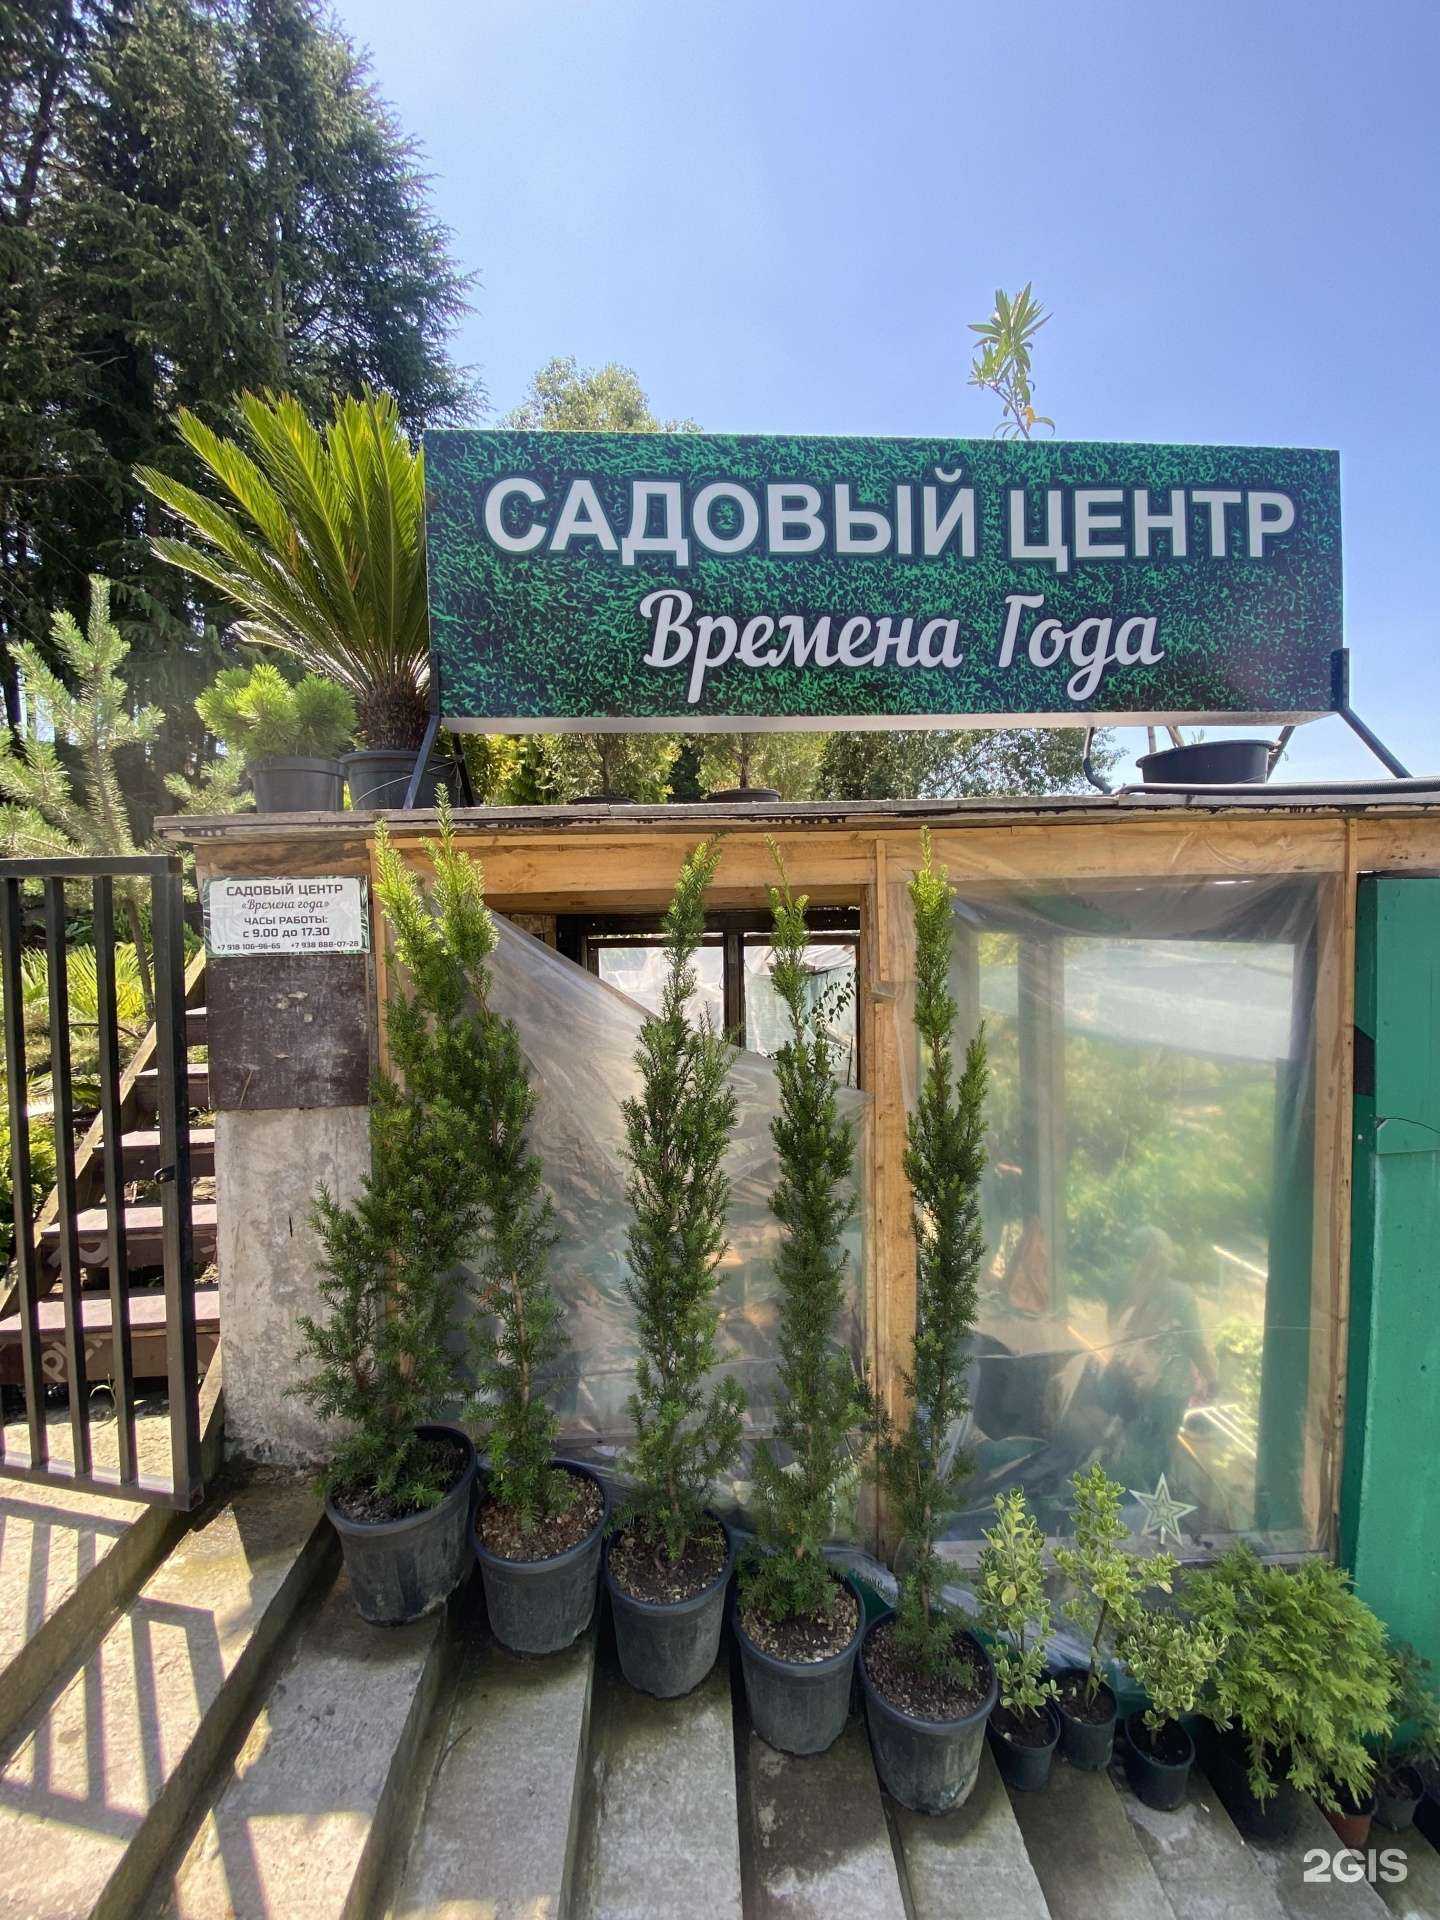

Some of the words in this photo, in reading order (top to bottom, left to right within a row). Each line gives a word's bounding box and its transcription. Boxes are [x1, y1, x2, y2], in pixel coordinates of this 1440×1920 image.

[484, 467, 976, 567] САДОВЫЙ
[1010, 489, 1295, 573] ЦЕНТР
[639, 589, 963, 704] Времена
[998, 593, 1165, 701] Года
[226, 882, 294, 897] САДОВЫЙ
[298, 884, 343, 896] ЦЕНТР
[244, 916, 276, 926] ЧАСЫ
[279, 915, 328, 925] РАБОТЫ:
[252, 928, 279, 938] 9.00
[281, 929, 298, 938] до
[301, 926, 330, 937] 17.30
